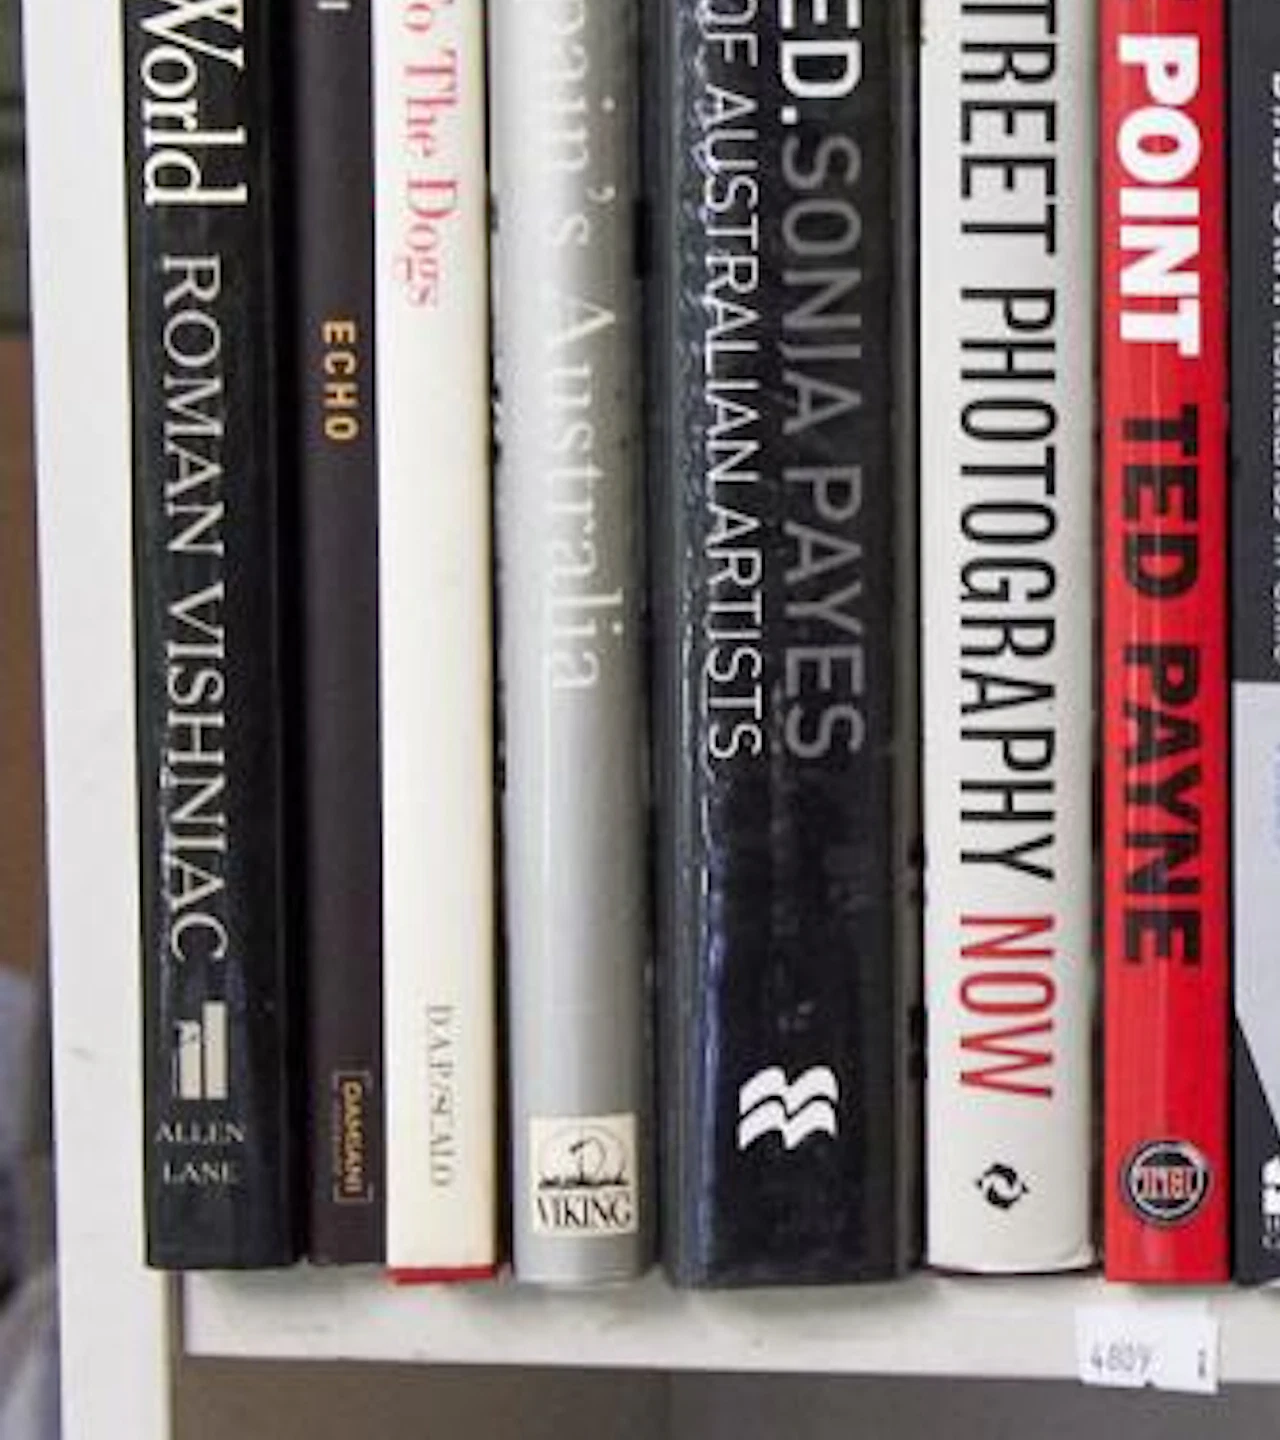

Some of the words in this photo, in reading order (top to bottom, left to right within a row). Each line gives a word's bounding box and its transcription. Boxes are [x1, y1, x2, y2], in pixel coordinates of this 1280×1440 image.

[404, 48, 458, 157] The
[1117, 35, 1202, 356] POINT
[394, 178, 459, 309] Dogs
[700, 86, 760, 482] AUSTRALIAN
[161, 254, 225, 557] ROMAN
[322, 320, 358, 442] ECHO
[545, 285, 623, 693] Australia
[1123, 404, 1199, 599] TED
[705, 505, 763, 759] ARTISTS
[784, 465, 864, 759] PAYES
[960, 288, 1057, 881] PHOTOGRAPHY
[163, 584, 229, 963] VISHNIAC
[1123, 644, 1201, 966] PAYNE
[155, 1119, 245, 1144] ALLEN
[960, 913, 1057, 1100] NOW
[162, 1161, 236, 1184] LANE
[535, 1192, 633, 1231] VIKING
